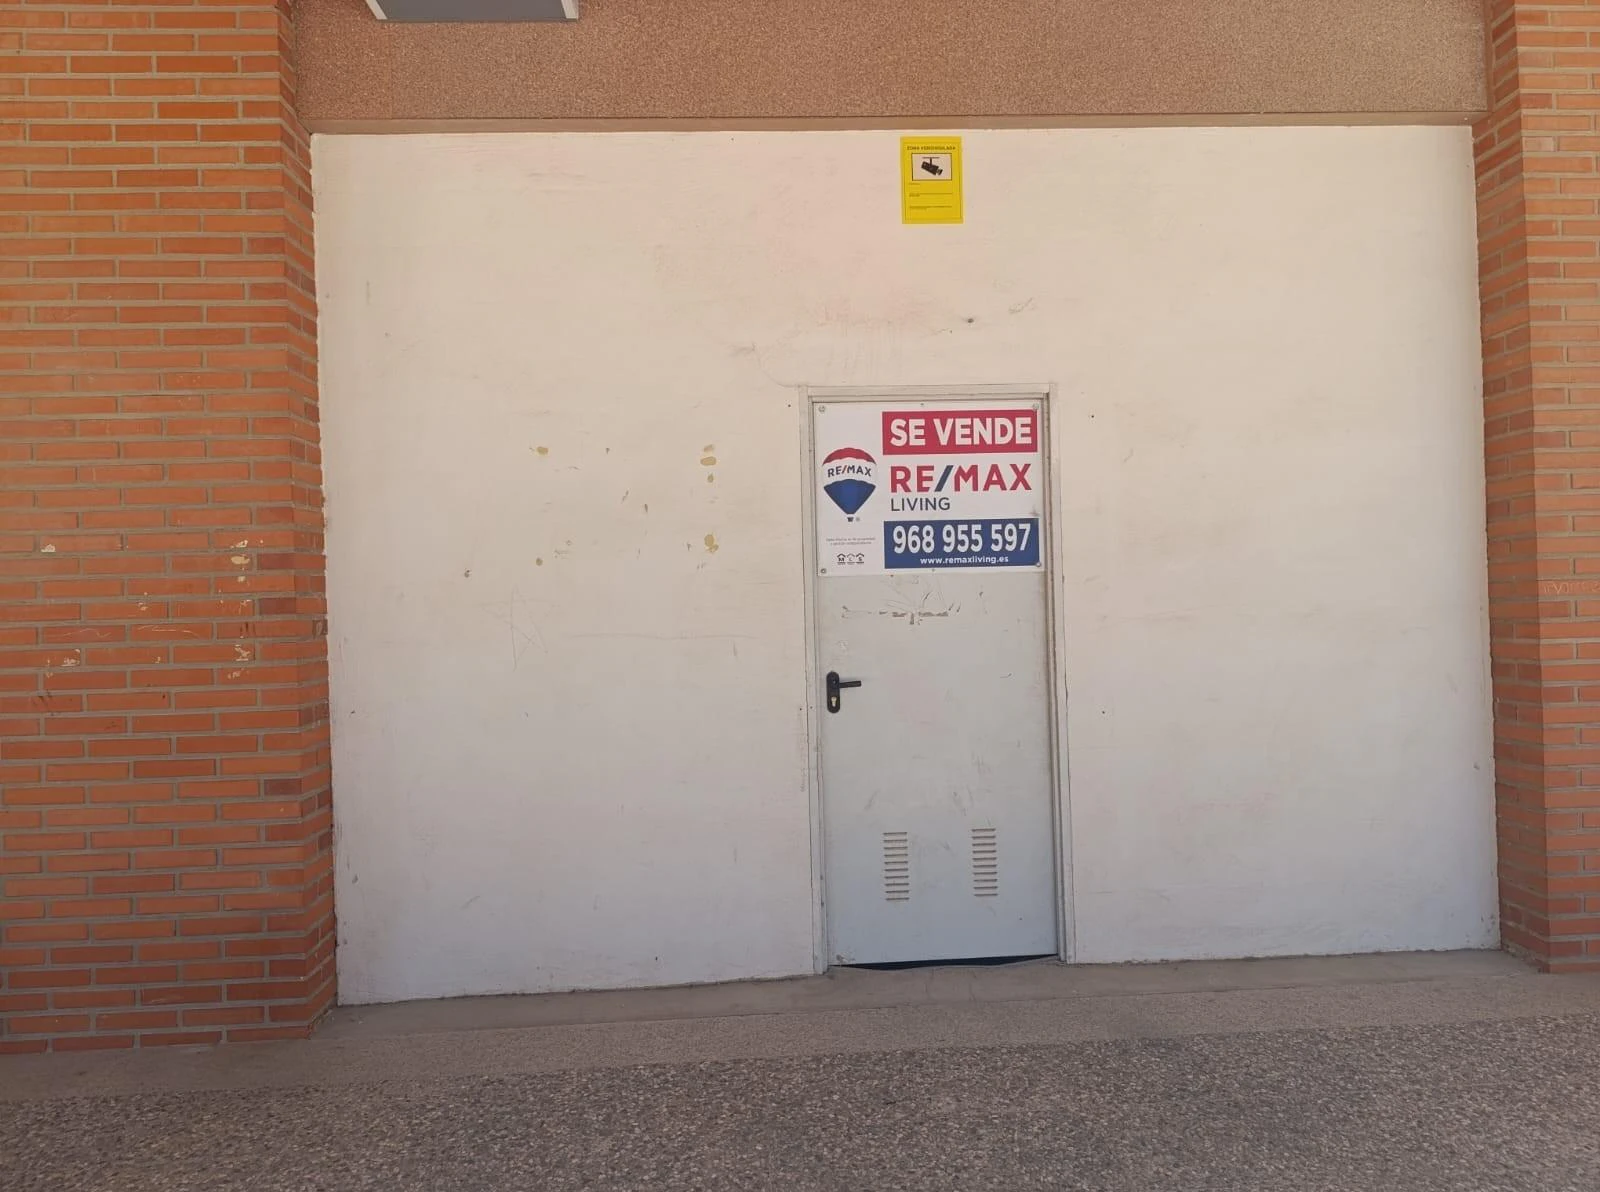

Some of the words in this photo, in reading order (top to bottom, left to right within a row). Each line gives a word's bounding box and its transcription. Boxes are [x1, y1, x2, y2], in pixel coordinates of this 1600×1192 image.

[890, 418, 926, 447] SE
[933, 417, 1033, 446] VENDE
[827, 464, 872, 478] RE/MAX
[890, 463, 1033, 493] RE/MAX
[891, 497, 951, 512] LIVING
[892, 525, 935, 554] 968
[942, 524, 983, 553] 955
[990, 523, 1032, 552] 597
[920, 555, 1009, 565] www.remaxliving.es
